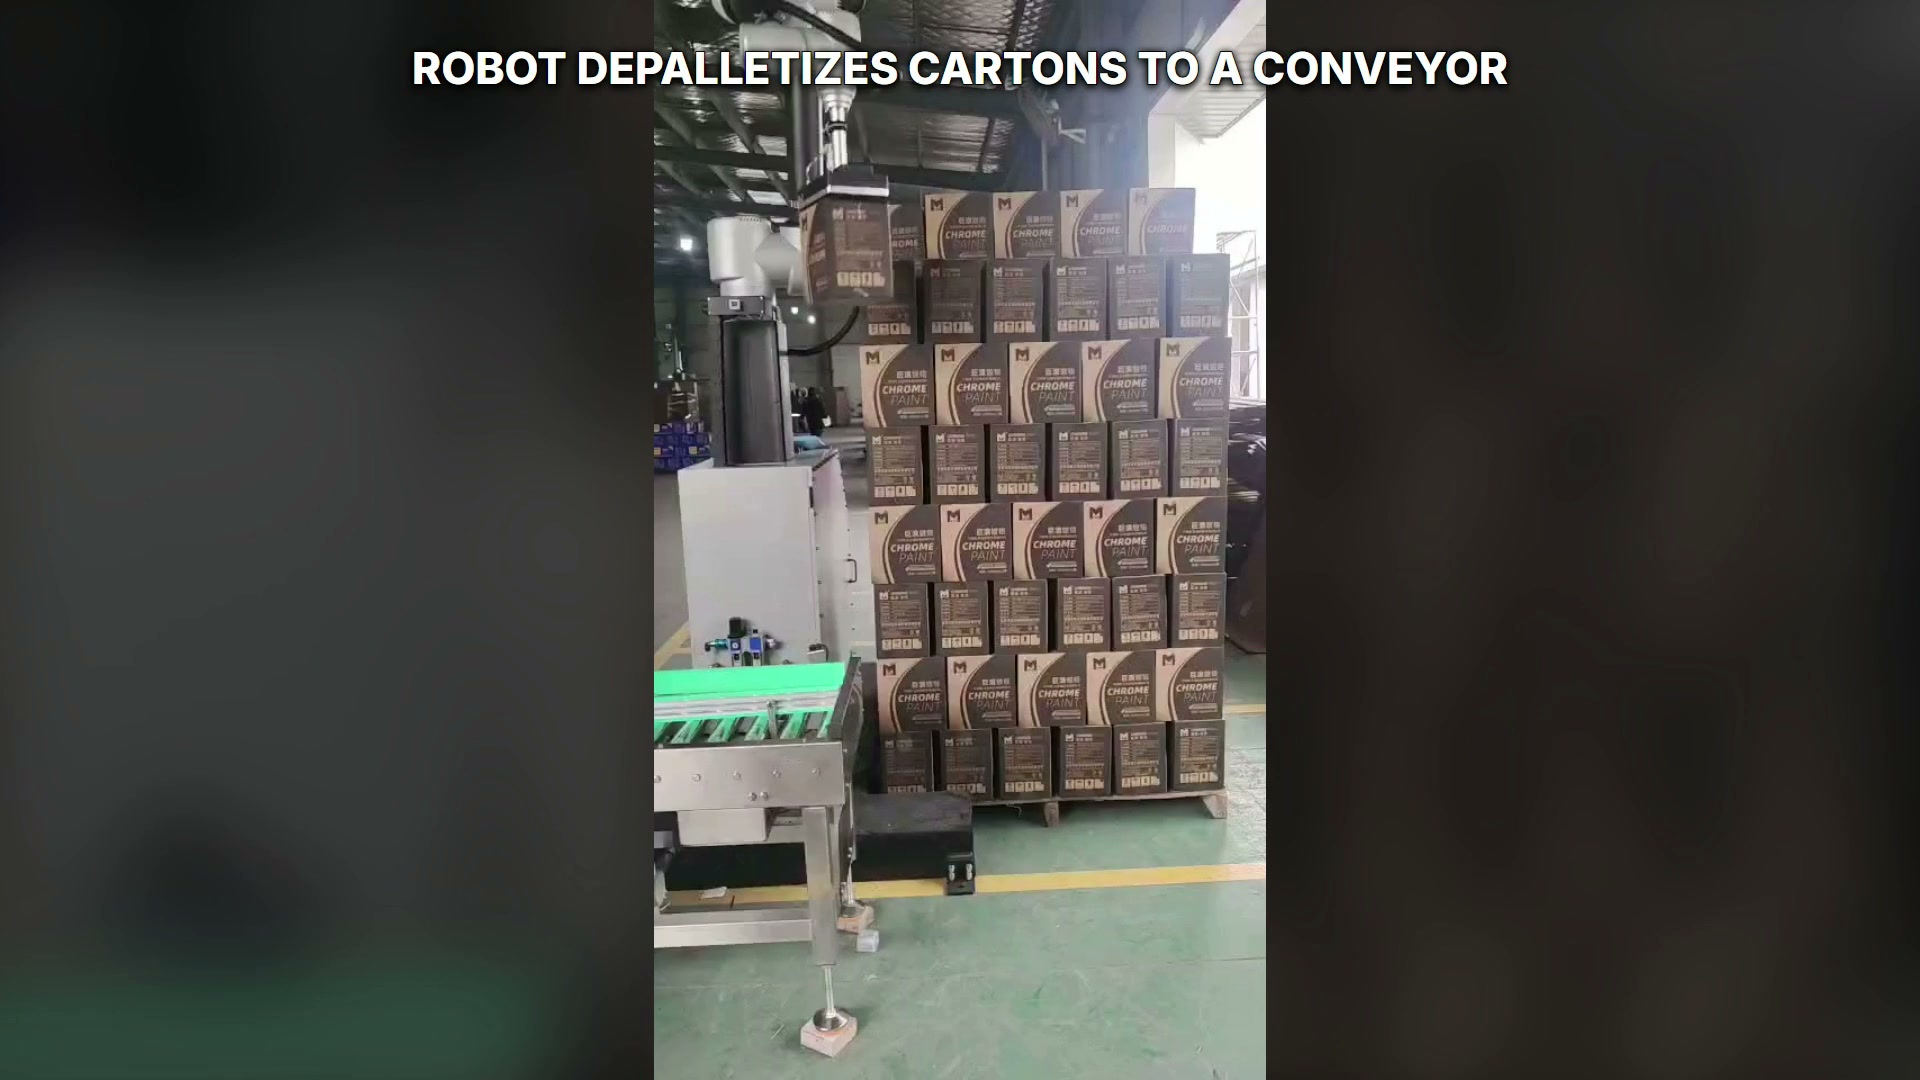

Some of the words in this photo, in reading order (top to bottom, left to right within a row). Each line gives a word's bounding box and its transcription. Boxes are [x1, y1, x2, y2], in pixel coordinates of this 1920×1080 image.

[931, 198, 943, 211] M
[998, 198, 1012, 210] M
[1067, 195, 1078, 208] M
[945, 230, 987, 239] CHROME
[1013, 228, 1054, 237] CHROME
[1080, 227, 1121, 236] CHROME
[892, 239, 919, 248] ROME
[1016, 348, 1030, 362] M
[1088, 346, 1102, 360] M
[1167, 344, 1180, 356] M
[866, 352, 880, 364] M
[942, 349, 955, 362] M
[956, 382, 1001, 392] CHROME
[1031, 382, 1075, 392] CHROME
[1104, 378, 1147, 388] CHROME
[1179, 377, 1223, 387] CHROME
[882, 384, 928, 395] CHROME
[1112, 388, 1148, 400] PAINT
[1187, 386, 1223, 397] PAINT
[891, 395, 928, 405] PAINT
[965, 392, 1001, 402] PAINT
[1039, 391, 1075, 402] PAINT
[1019, 508, 1032, 521] M
[1090, 507, 1103, 520] M
[1164, 504, 1176, 516] M
[875, 512, 889, 524] M
[947, 510, 961, 523] M
[1104, 537, 1148, 547] CHROME
[1177, 534, 1220, 544] CHROME
[890, 543, 934, 553] CHROME
[962, 541, 1006, 551] CHROME
[1034, 540, 1076, 550] CHROME
[1184, 543, 1220, 554] PAINT
[971, 551, 1006, 561] PAINT
[1041, 549, 1077, 559] PAINT
[1112, 546, 1148, 557] PAINT
[899, 552, 934, 563] PAINT
[1093, 658, 1106, 670] M
[1162, 654, 1175, 666] M
[883, 664, 896, 676] M
[953, 662, 967, 674] M
[1024, 660, 1037, 672] M
[1107, 686, 1150, 696] CHROME
[1176, 683, 1218, 693] CHROME
[898, 693, 941, 703] CHROME
[969, 691, 1011, 700] CHROME
[1039, 689, 1080, 698] CHROME
[1184, 692, 1218, 702] PAINT
[977, 700, 1010, 711] PAINT
[1047, 698, 1079, 708] PAINT
[1116, 696, 1148, 705] PAINT
[907, 702, 941, 712] PAINT
